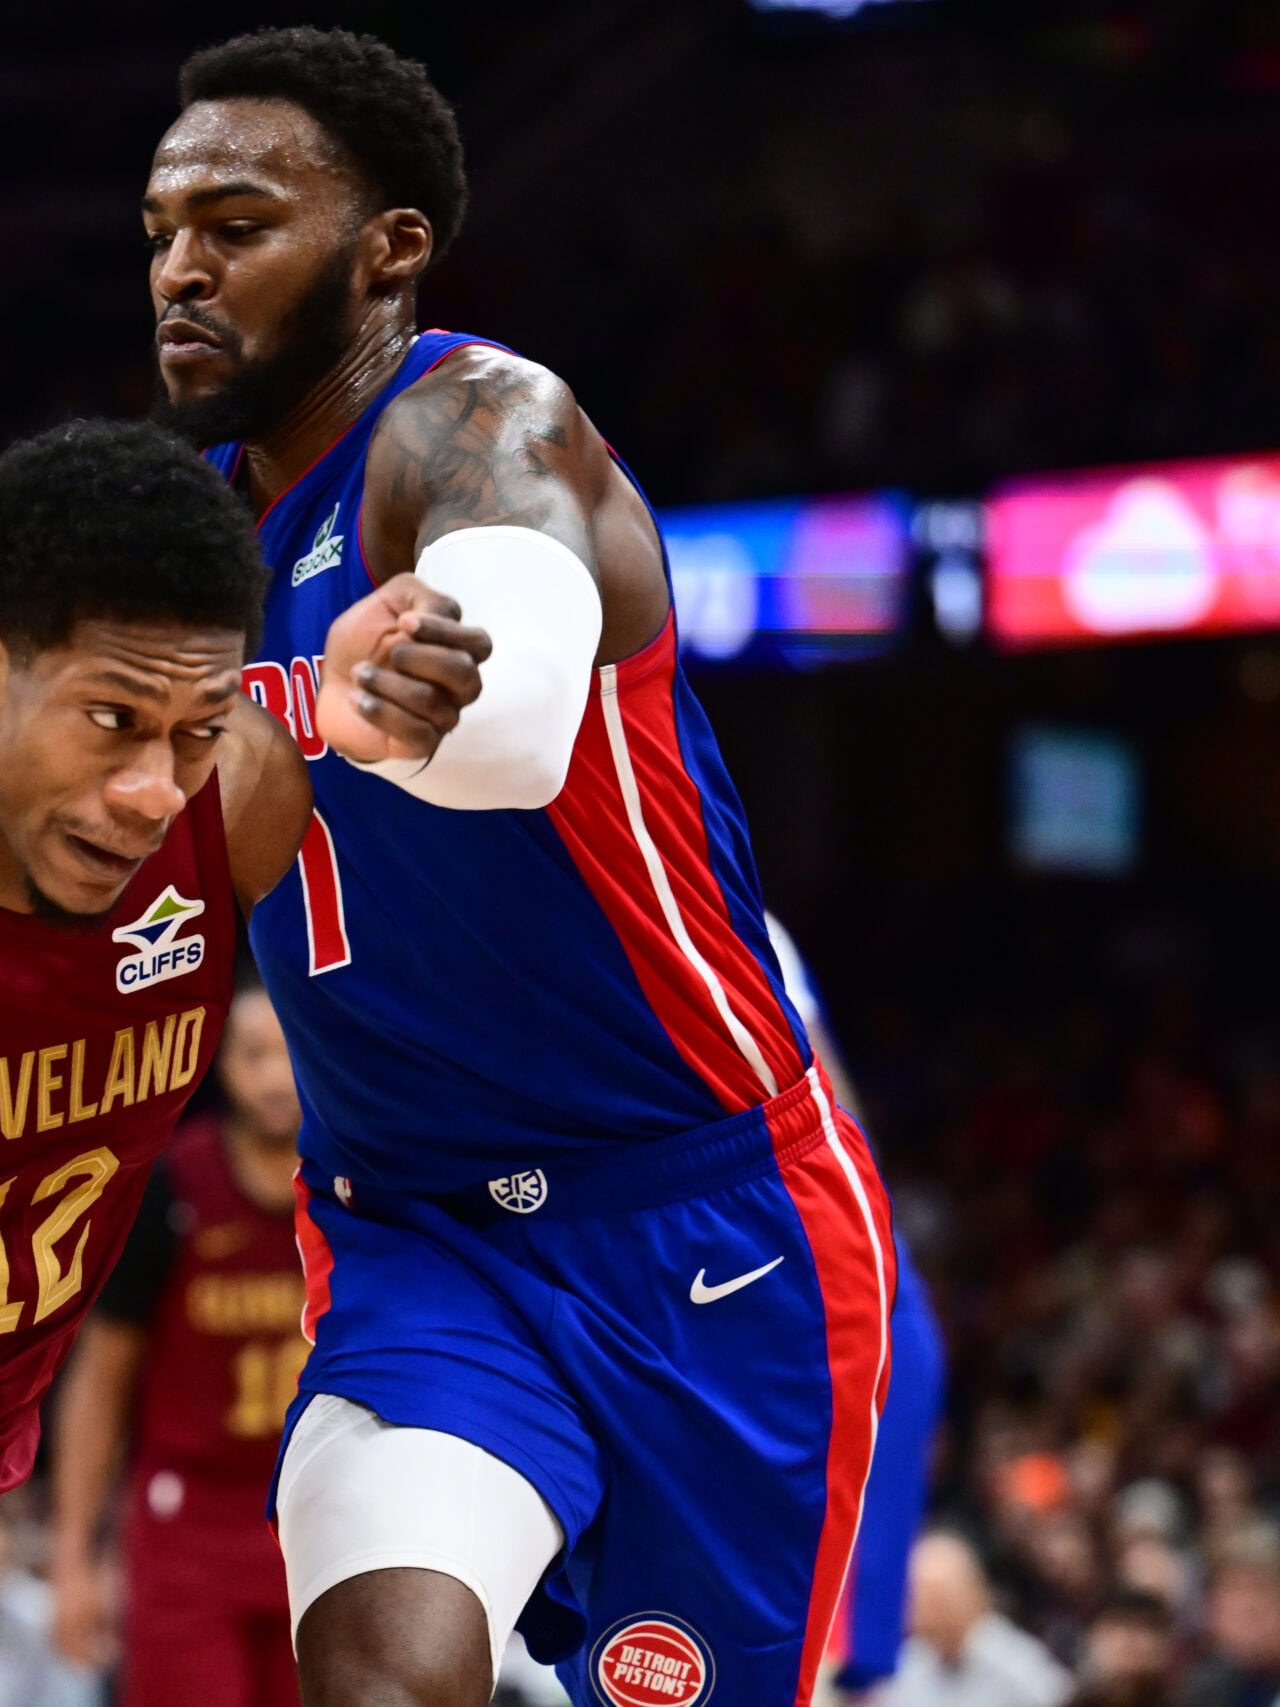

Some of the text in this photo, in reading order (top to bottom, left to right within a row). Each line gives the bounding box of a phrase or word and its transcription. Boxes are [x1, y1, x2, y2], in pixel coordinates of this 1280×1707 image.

[119, 942, 201, 985] CLIFFS
[621, 1645, 692, 1680] DETROIT
[613, 1663, 687, 1698] PISTONS
